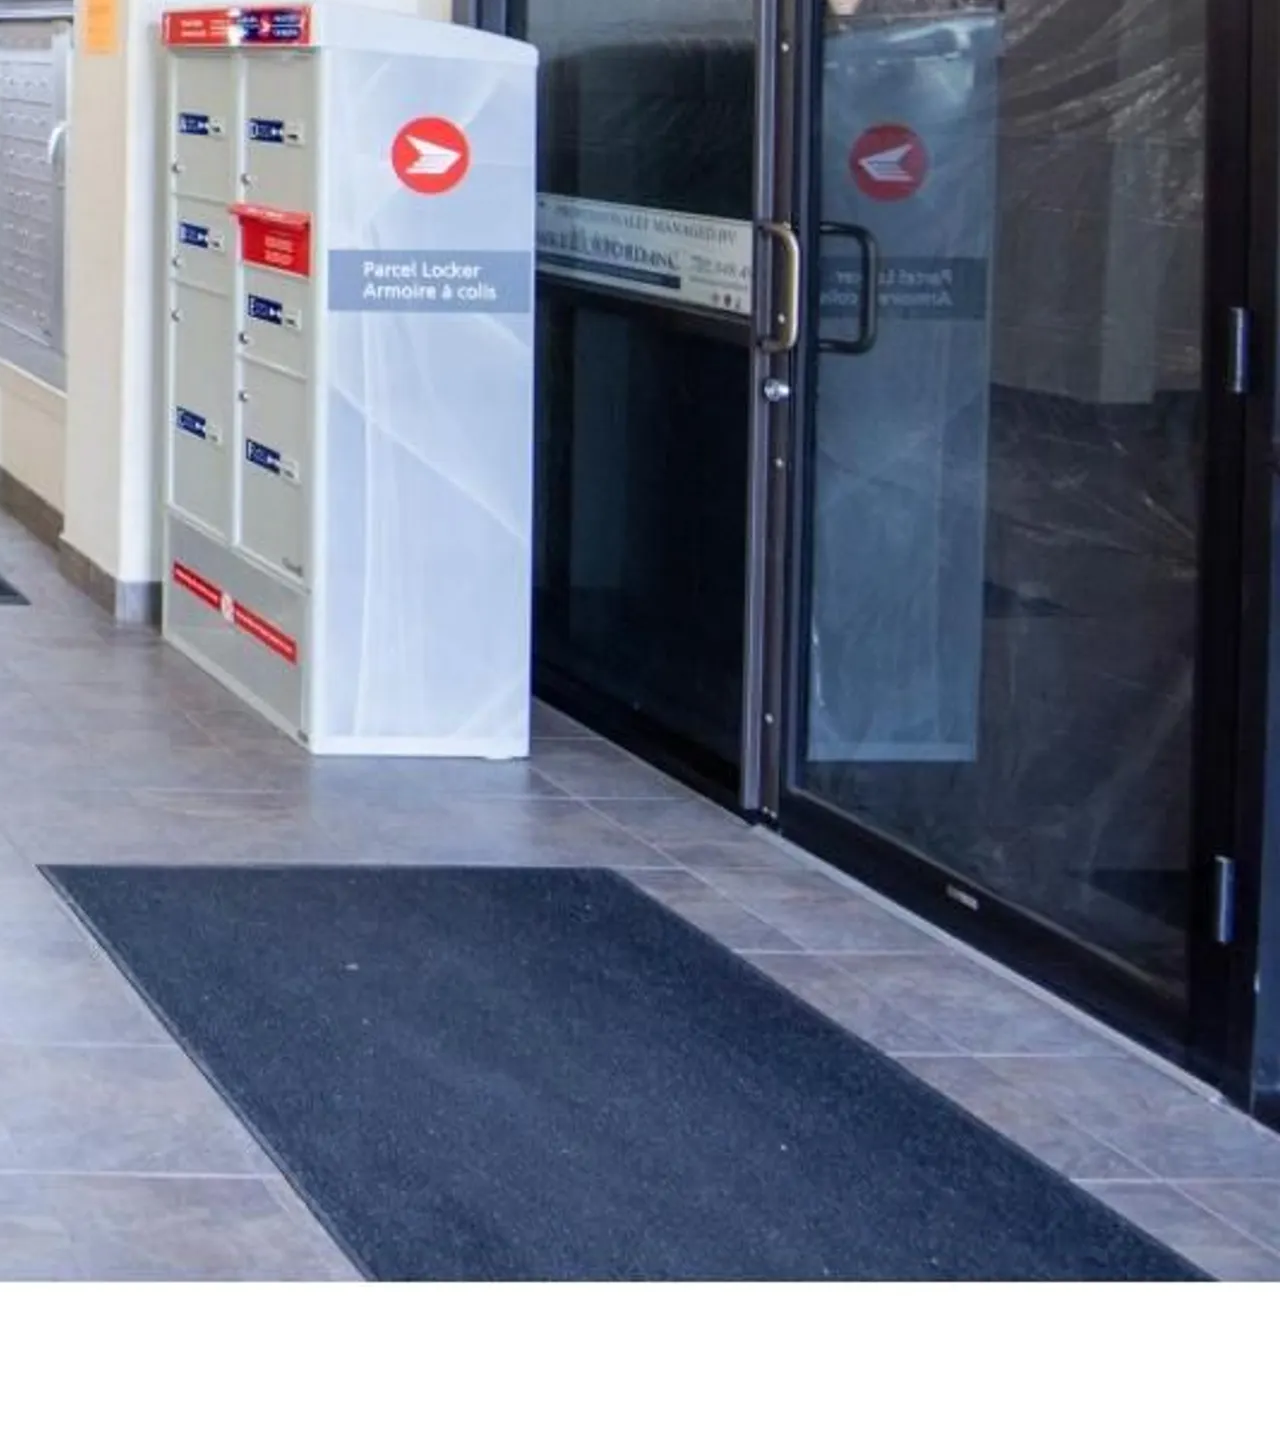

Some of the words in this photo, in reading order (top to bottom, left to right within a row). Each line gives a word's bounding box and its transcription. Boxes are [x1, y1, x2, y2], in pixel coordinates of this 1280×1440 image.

[363, 260, 417, 279] Parcel
[422, 261, 482, 279] Locker
[363, 282, 437, 300] Armoire
[441, 282, 452, 300] à
[456, 282, 497, 301] colis
